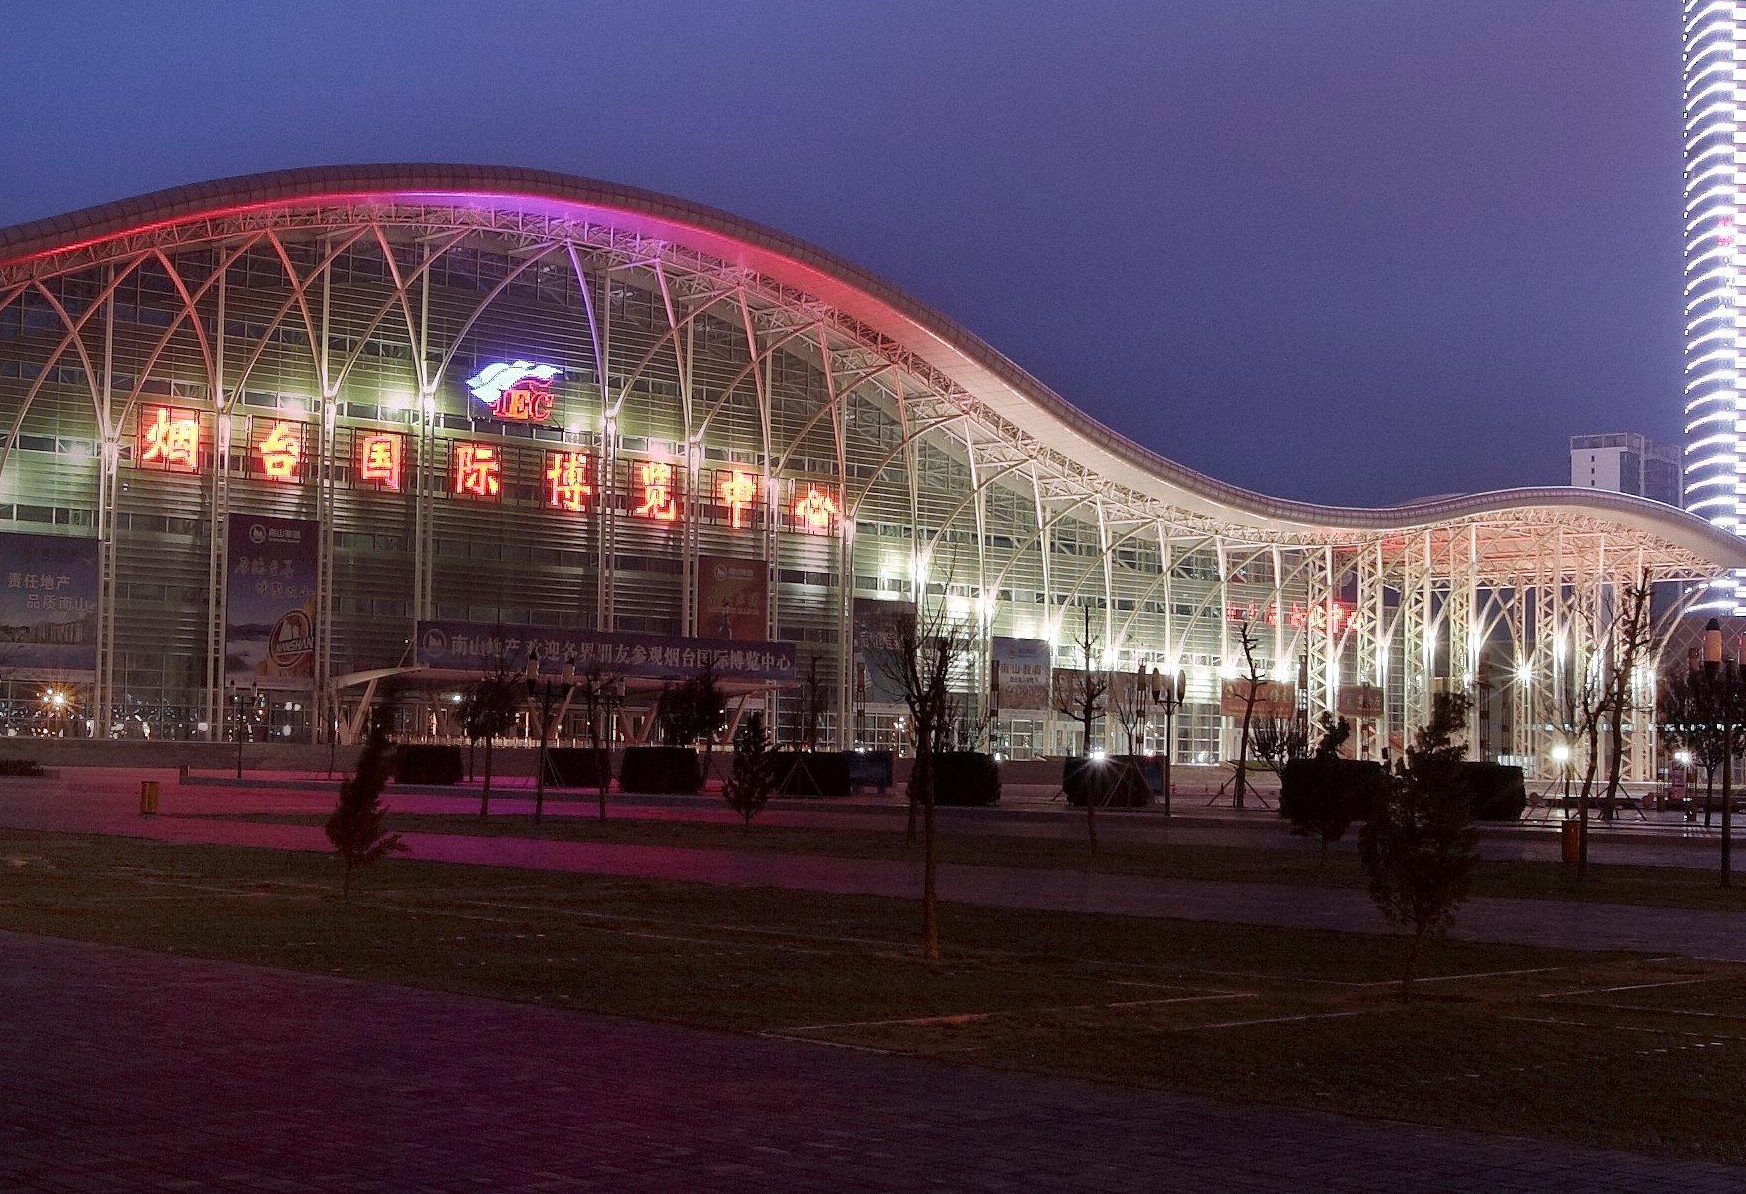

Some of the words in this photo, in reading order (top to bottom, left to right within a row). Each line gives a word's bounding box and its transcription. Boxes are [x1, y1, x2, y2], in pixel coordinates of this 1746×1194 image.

[142, 407, 838, 529] 烟台国际博览中心
[8, 572, 70, 590] 责任地产
[27, 593, 88, 612] 品质南山
